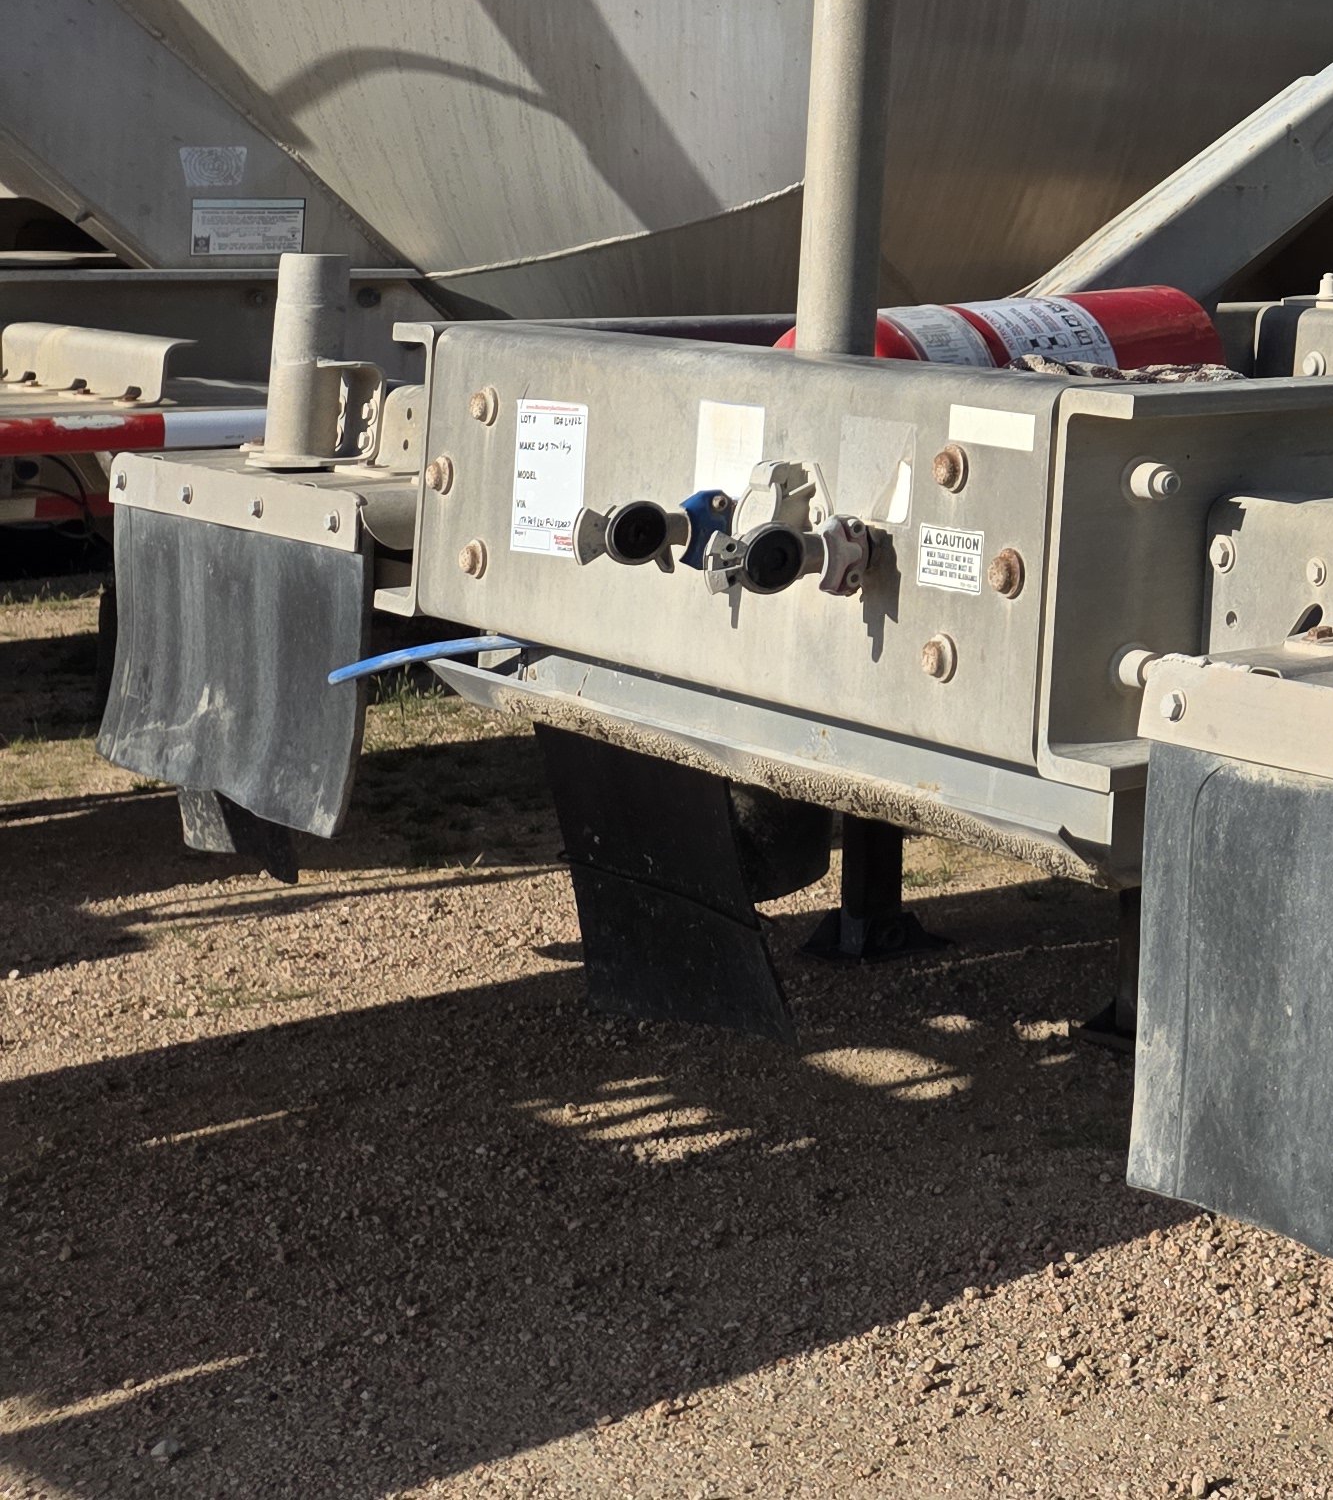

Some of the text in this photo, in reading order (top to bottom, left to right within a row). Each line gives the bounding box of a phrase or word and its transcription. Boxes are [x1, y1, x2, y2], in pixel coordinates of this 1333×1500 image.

[520, 415, 531, 424] LOT
[519, 442, 536, 451] MAKE
[517, 470, 537, 480] MODEL
[936, 532, 980, 551] CAUTION
